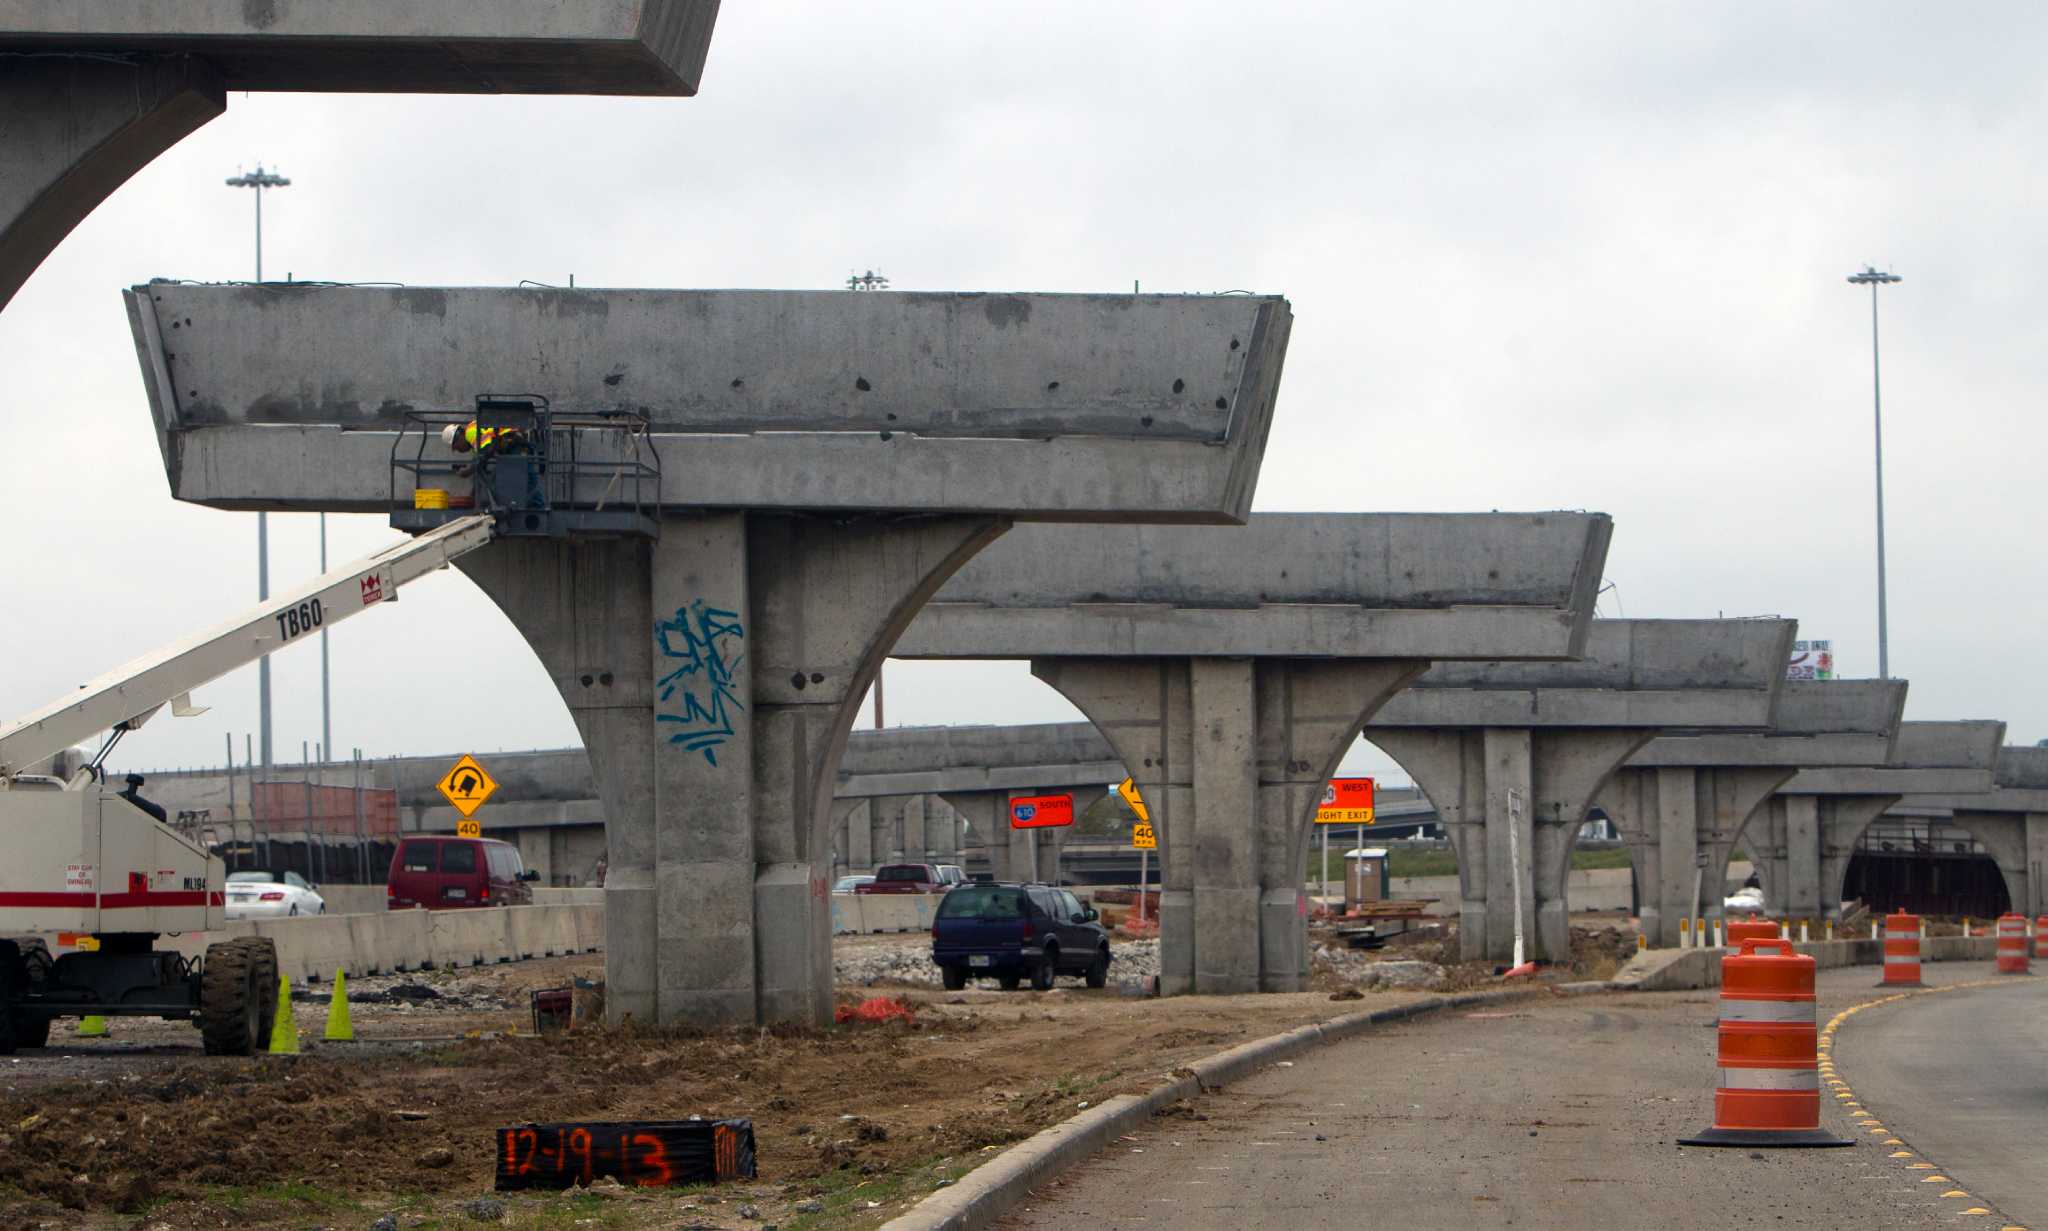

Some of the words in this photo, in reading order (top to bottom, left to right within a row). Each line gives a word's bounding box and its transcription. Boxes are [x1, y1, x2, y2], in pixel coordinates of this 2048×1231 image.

[276, 598, 323, 641] TB60
[1342, 783, 1369, 792] WEST
[1016, 807, 1033, 817] 610
[1039, 799, 1071, 809] SOUTH
[1319, 811, 1343, 819] IGHT
[1347, 811, 1369, 819] EXIT
[460, 823, 479, 835] 40
[1135, 827, 1154, 839] 40
[183, 876, 207, 891] ML194
